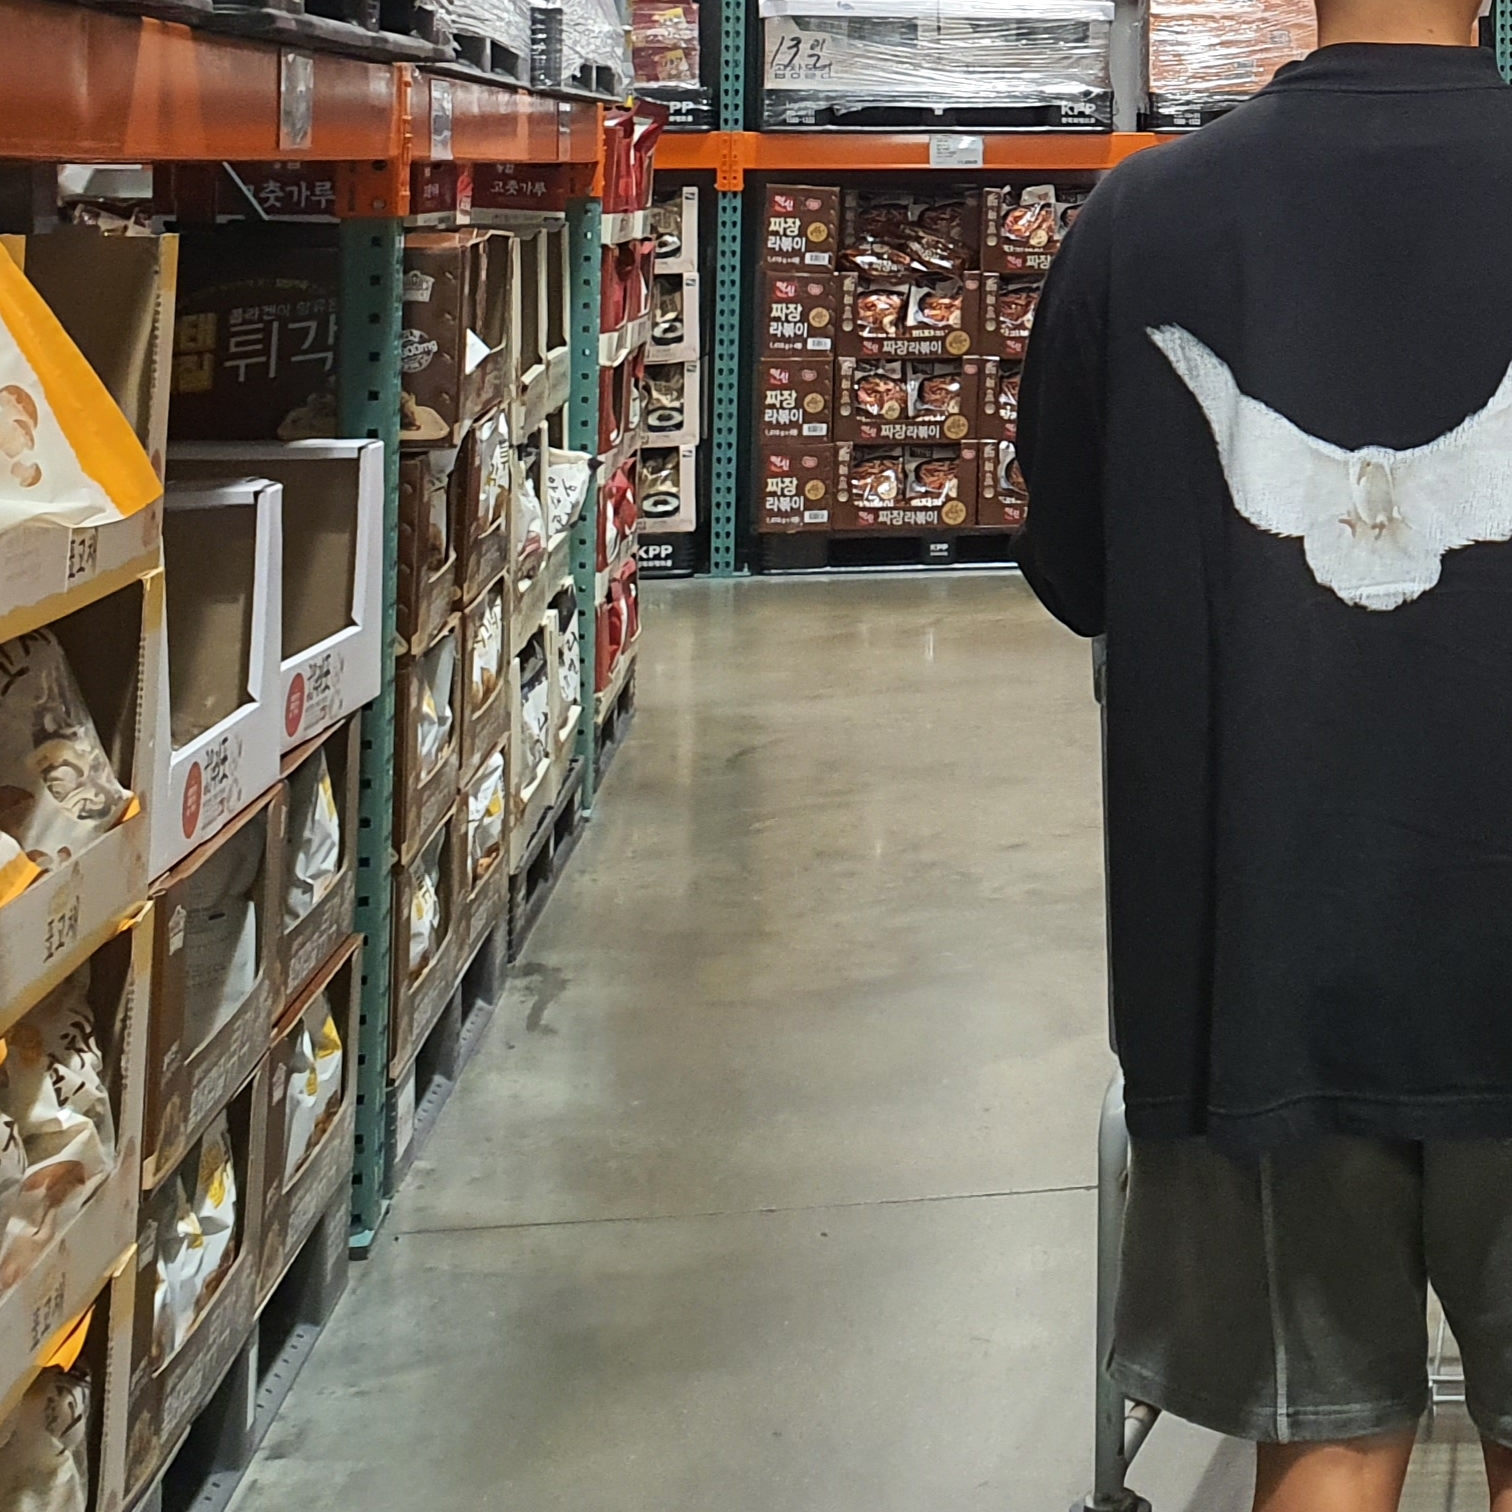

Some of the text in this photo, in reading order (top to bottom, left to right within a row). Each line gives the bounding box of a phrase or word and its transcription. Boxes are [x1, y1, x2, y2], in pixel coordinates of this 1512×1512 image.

[670, 102, 693, 113] PP
[1061, 103, 1097, 115] KPP
[490, 179, 547, 197] 고춧가루
[768, 217, 801, 236] 짜장
[767, 236, 806, 252] 라볶이
[770, 303, 802, 321] 짜장
[769, 322, 808, 338] 라볶이
[223, 315, 338, 383] 튀각
[882, 341, 942, 355] 짜장라볶이
[765, 390, 797, 407] 짜장
[765, 409, 803, 424] 라볶이
[880, 424, 940, 439] 짜장라볶이
[766, 477, 798, 495] 짜장
[765, 496, 804, 511] 라볶이
[878, 510, 938, 525] 짜장라볶이
[637, 546, 672, 559] KPP
